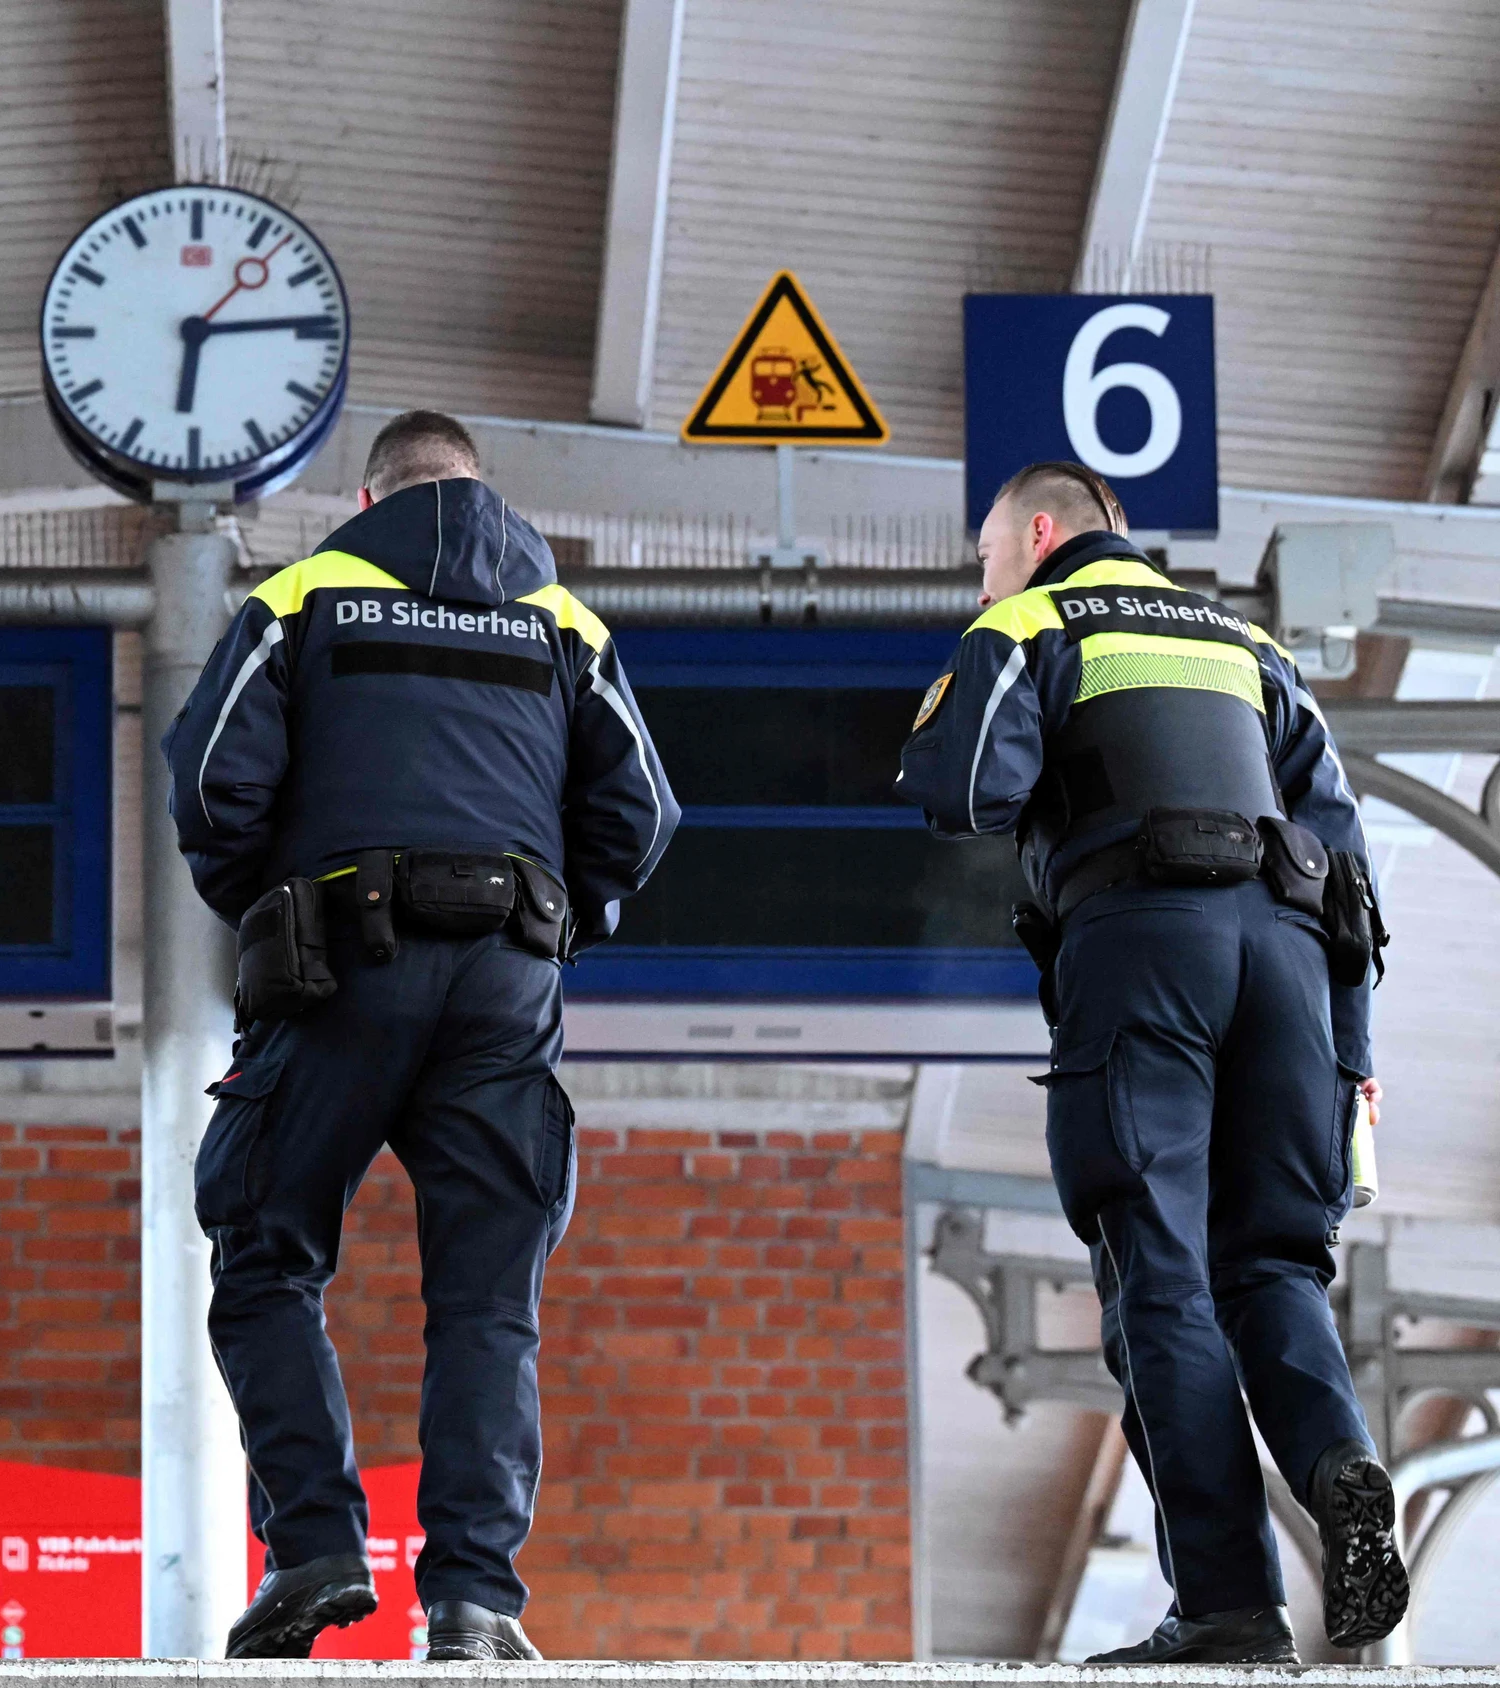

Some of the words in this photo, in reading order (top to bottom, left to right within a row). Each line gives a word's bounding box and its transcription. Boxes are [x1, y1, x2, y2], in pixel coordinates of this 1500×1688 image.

[1063, 303, 1182, 478] 6
[336, 600, 383, 625] DB
[391, 601, 549, 645] Sicherheit
[1061, 597, 1110, 620] DB
